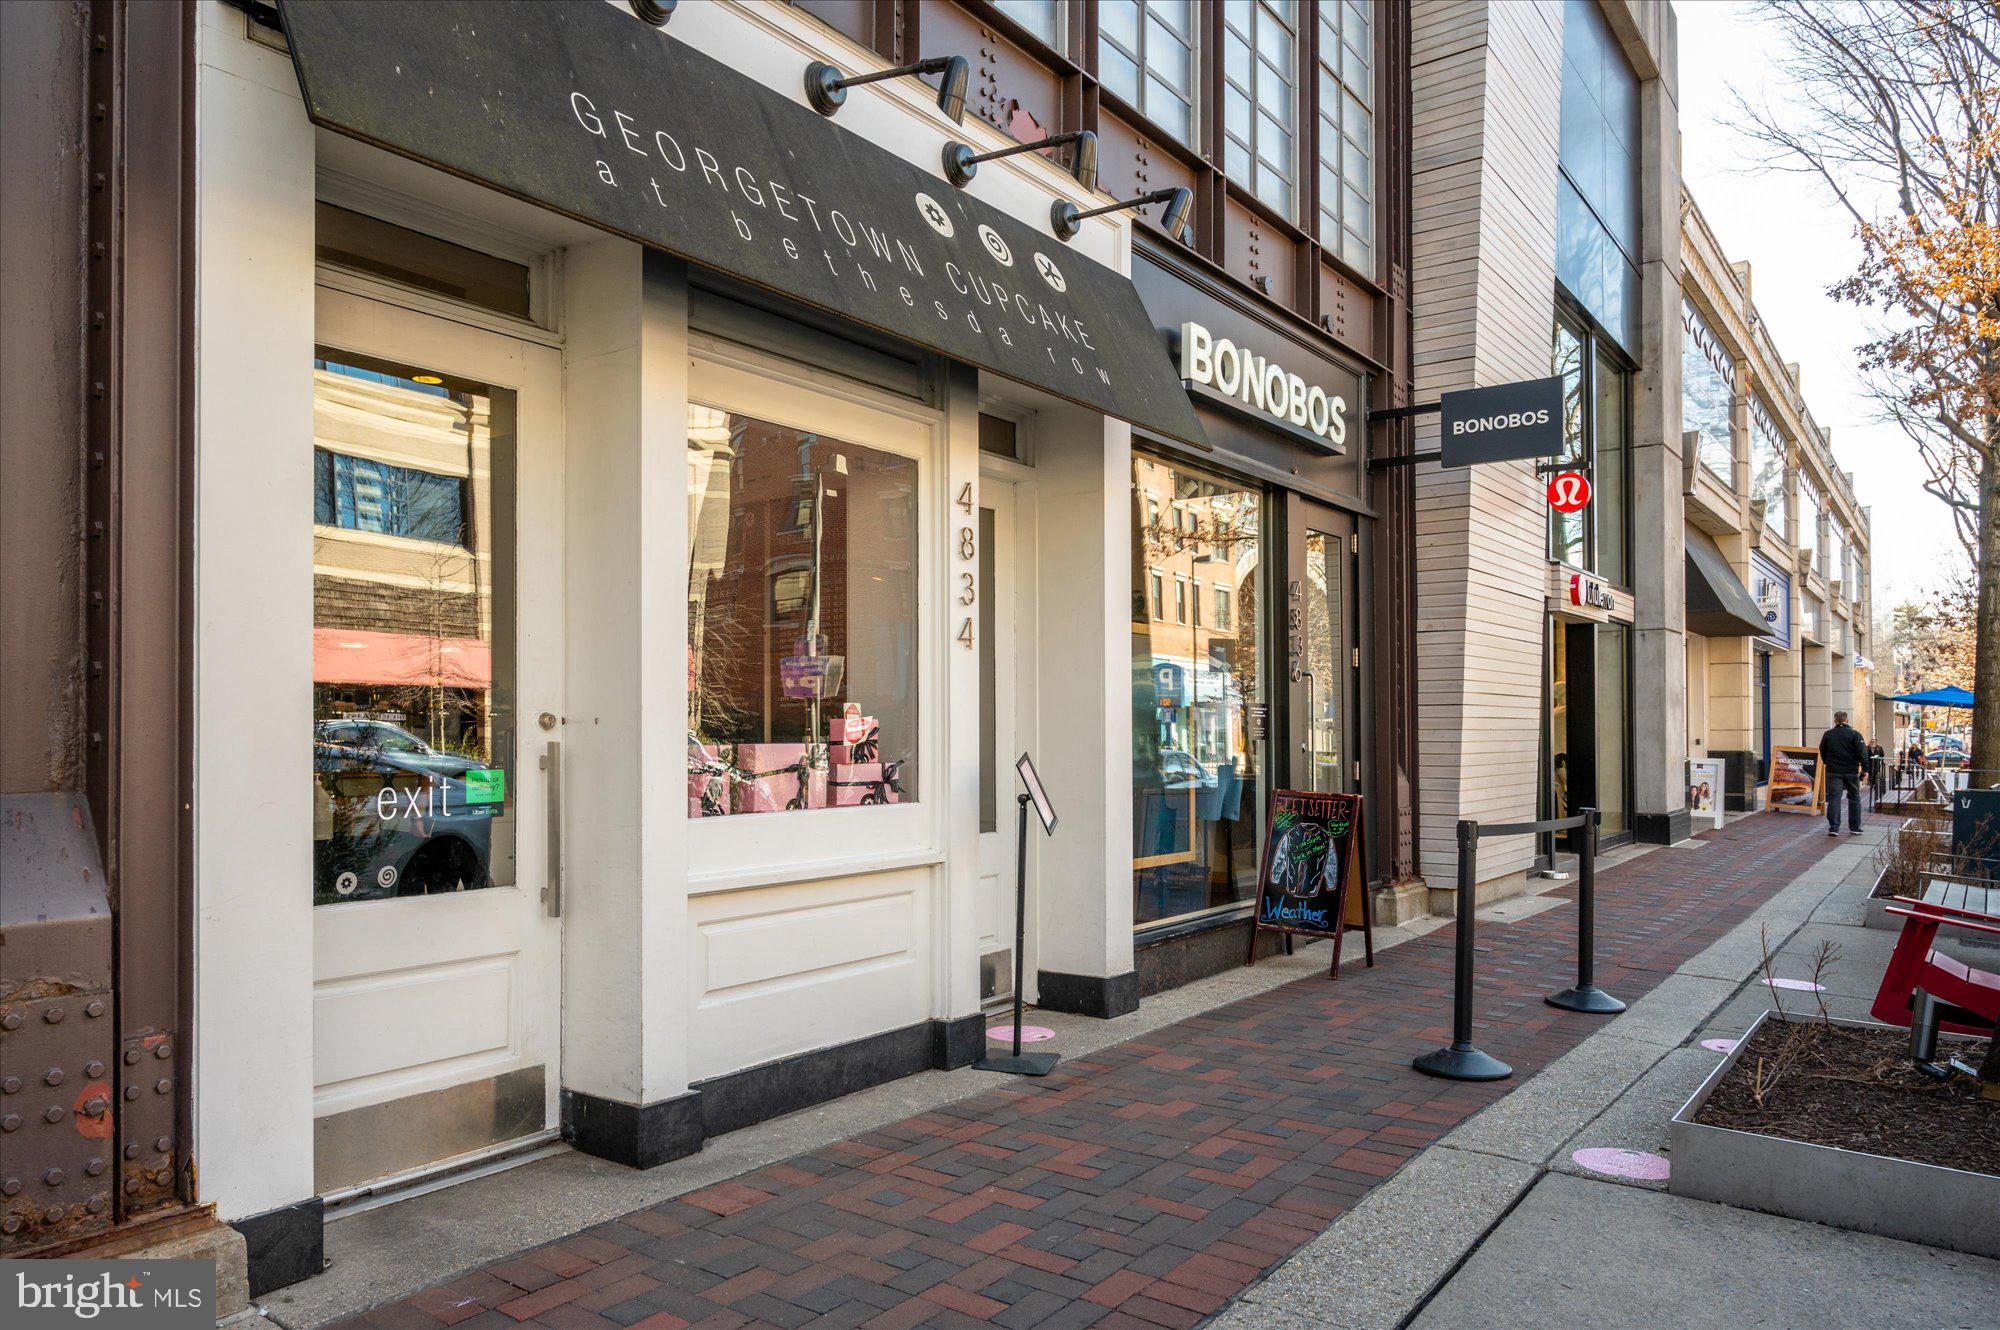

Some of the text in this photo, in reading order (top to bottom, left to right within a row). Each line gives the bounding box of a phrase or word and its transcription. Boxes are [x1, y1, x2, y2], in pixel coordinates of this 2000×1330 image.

[570, 91, 1096, 352] GEORGETOWN CUPCAKE
[597, 159, 1112, 387] at bethesda row
[1181, 321, 1347, 446] BONOBOS
[1452, 409, 1550, 436] BONOBOS
[377, 775, 452, 821] exit
[472, 808, 485, 816] Uber
[1262, 895, 1329, 924] Weather
